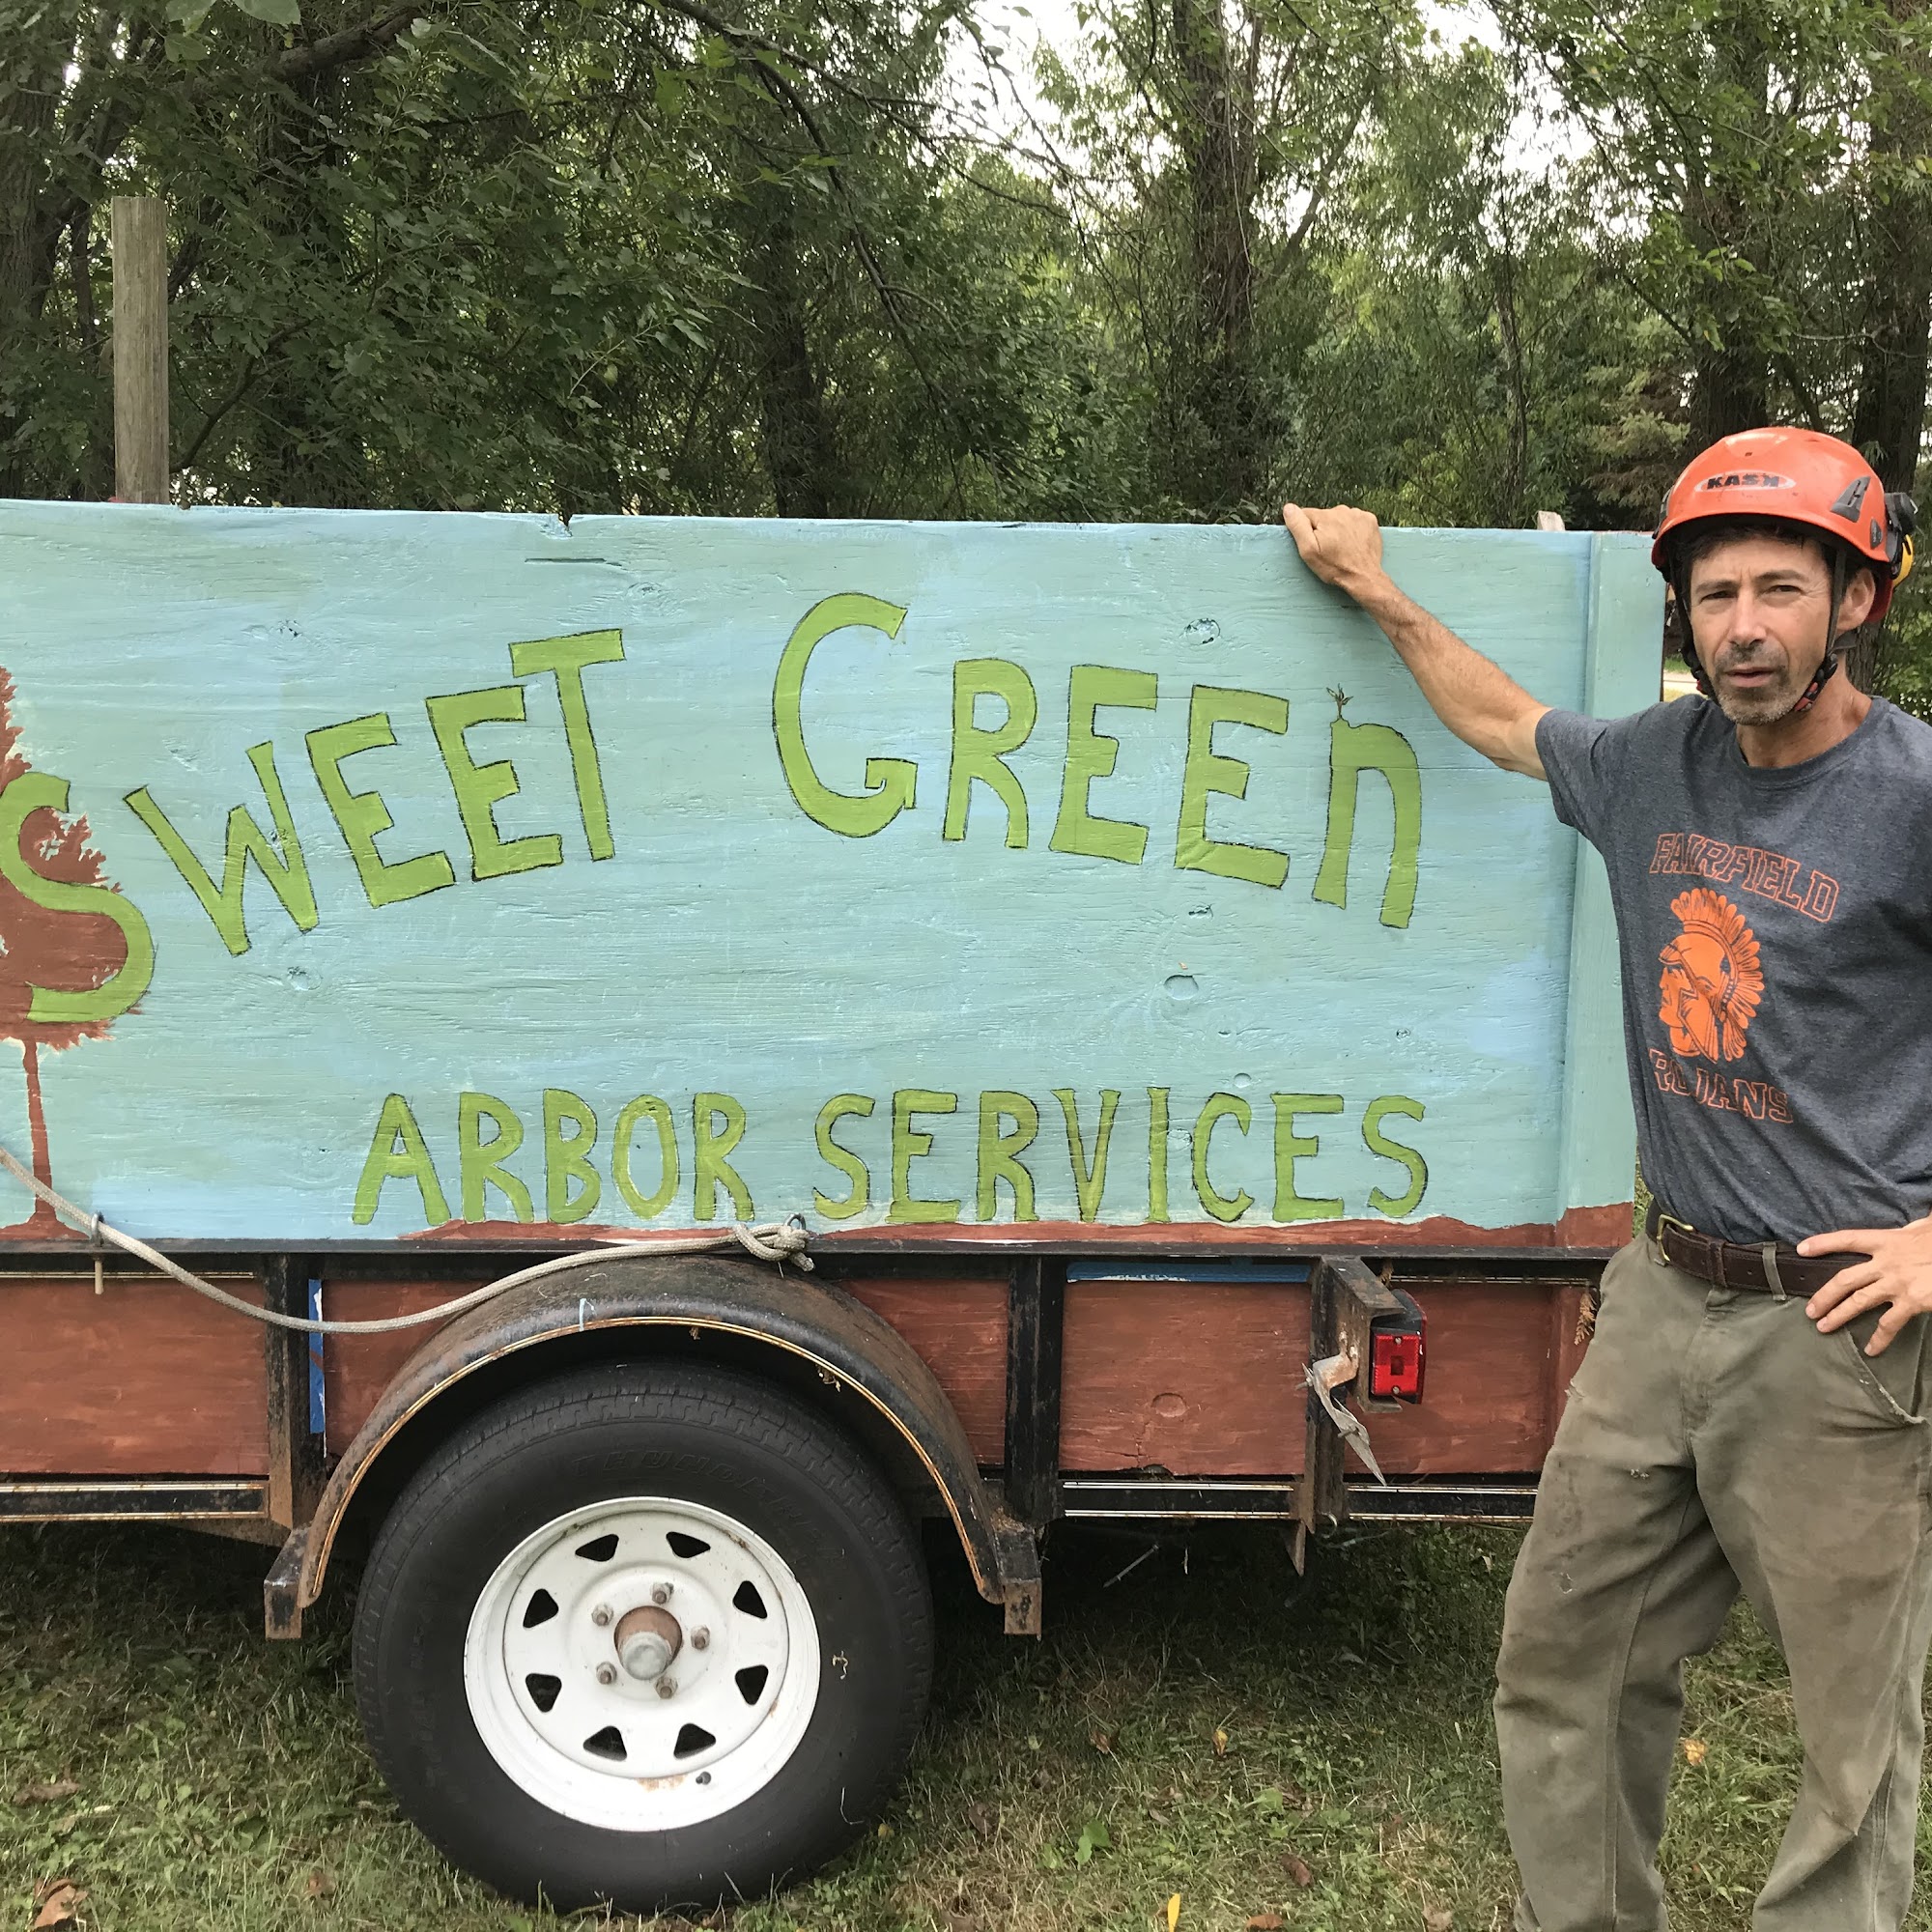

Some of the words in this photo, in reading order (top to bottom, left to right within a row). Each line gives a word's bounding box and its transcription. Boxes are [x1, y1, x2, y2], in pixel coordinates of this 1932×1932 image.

[0, 628, 625, 1024] SWEET
[1649, 833, 1840, 923] FAIRFIELD
[352, 1088, 755, 1226] ARBOR
[811, 1087, 1429, 1223] SERVICES
